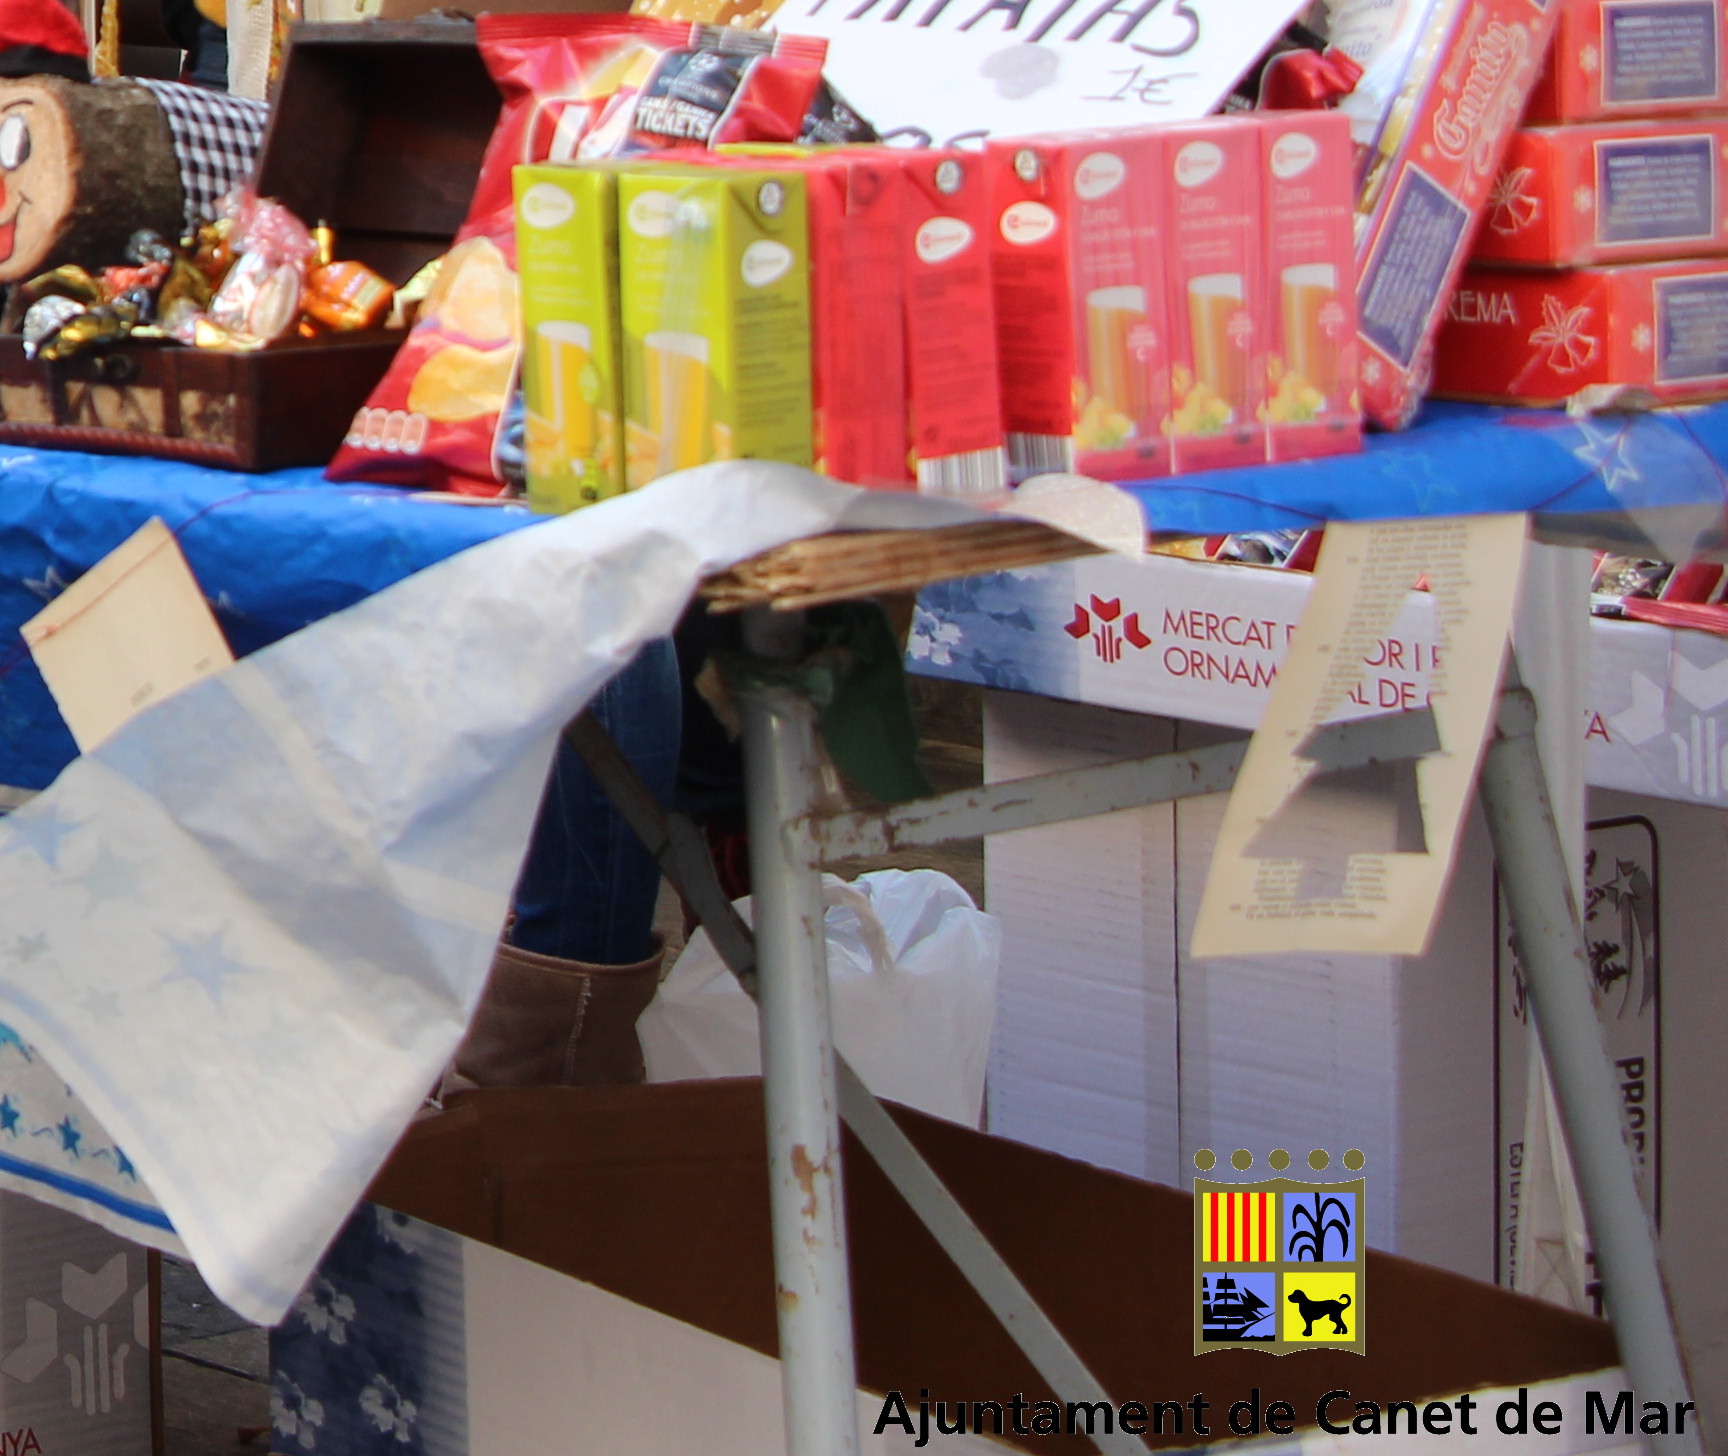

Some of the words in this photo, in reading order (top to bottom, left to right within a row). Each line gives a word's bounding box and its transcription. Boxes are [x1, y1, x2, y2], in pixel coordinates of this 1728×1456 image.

[635, 107, 712, 141] TICKETS
[1162, 607, 1276, 650] MERCAT
[1378, 678, 1417, 713] DE
